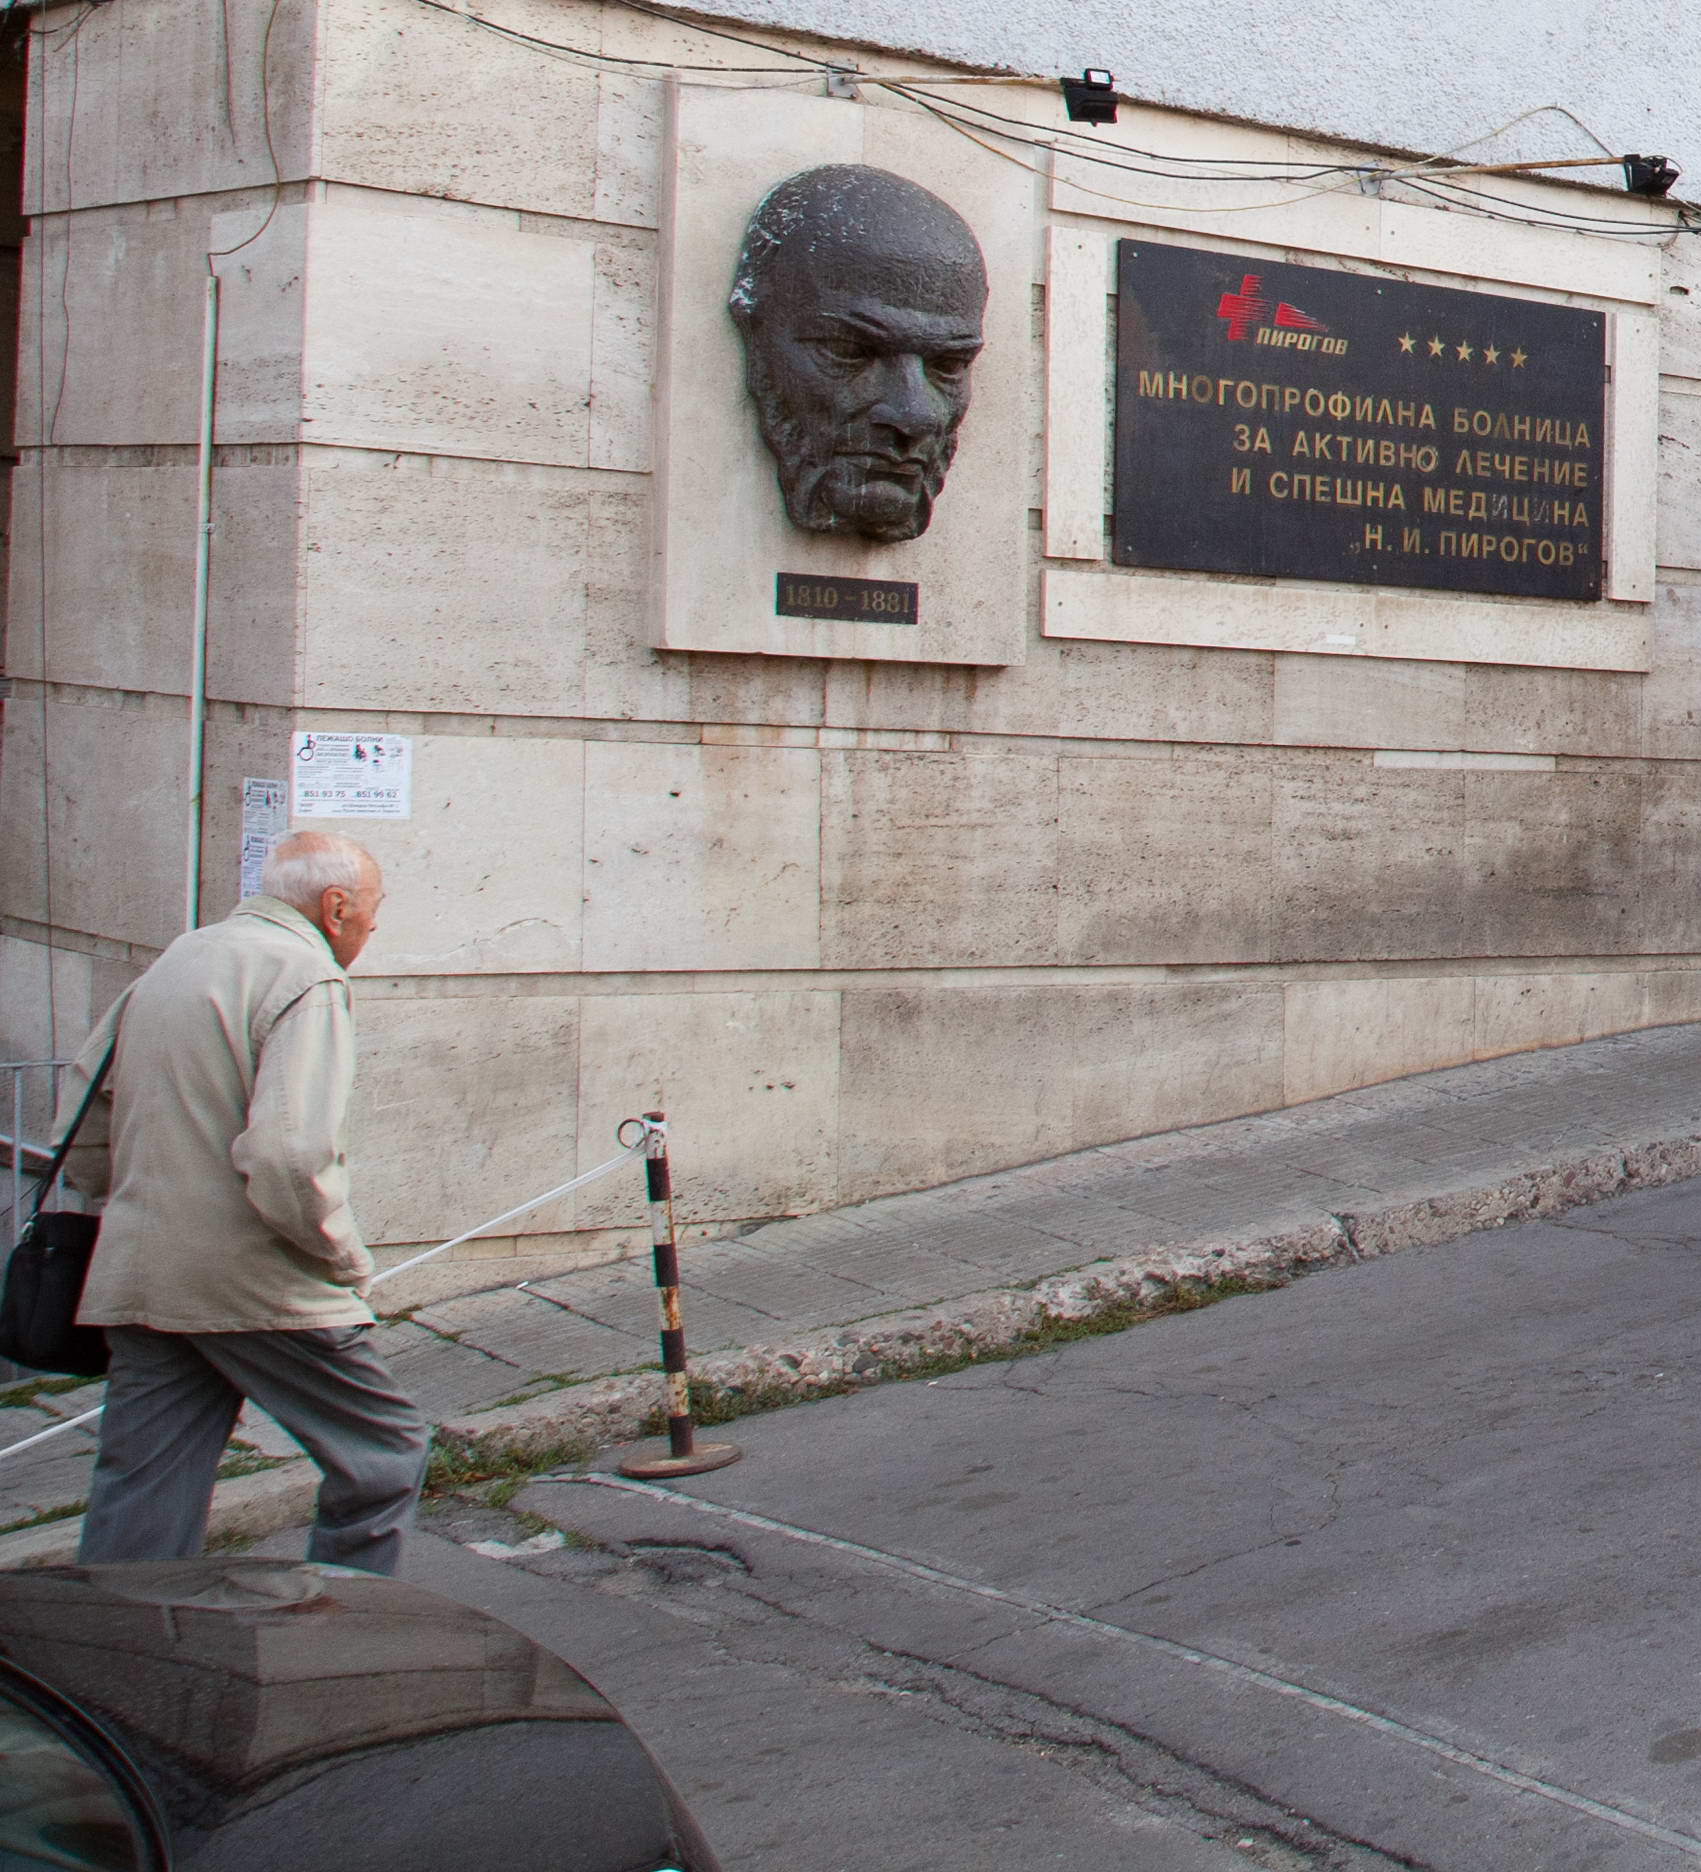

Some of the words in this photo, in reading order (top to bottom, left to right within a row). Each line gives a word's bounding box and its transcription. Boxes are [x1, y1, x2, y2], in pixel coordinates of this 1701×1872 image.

[1257, 327, 1348, 355] ПИРОГОВ
[1139, 370, 1436, 430] МНОГОПРОФИЛНА
[1453, 407, 1591, 450] БОЛНИЦА
[1233, 424, 1272, 454] ЗА
[1292, 430, 1439, 473] АКТИВНО
[1456, 449, 1588, 487] ЛЕЧЕНИЕ
[1231, 467, 1251, 495] И
[1269, 471, 1407, 510] СПЕШНА
[1424, 487, 1589, 527] МЕДИЦИНА
[1403, 528, 1430, 554] И.
[786, 584, 838, 609] 1810
[861, 590, 909, 613] 1881
